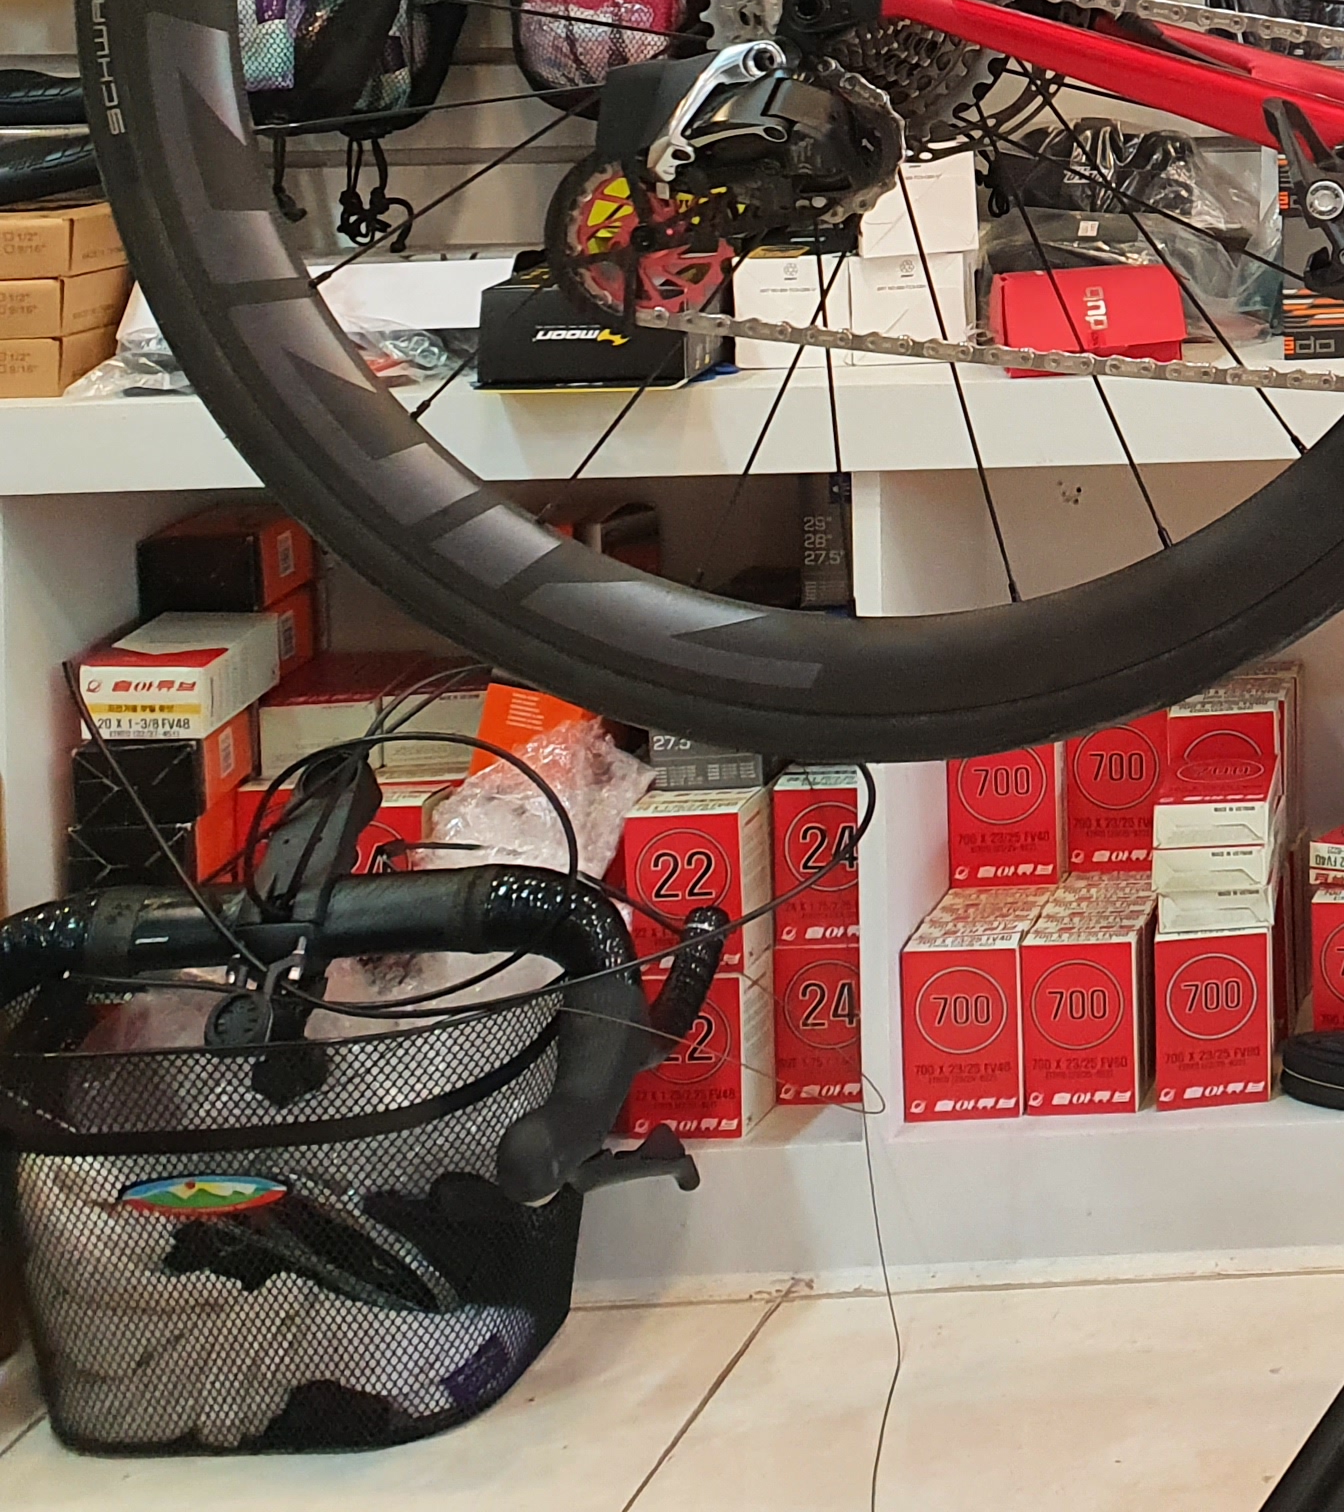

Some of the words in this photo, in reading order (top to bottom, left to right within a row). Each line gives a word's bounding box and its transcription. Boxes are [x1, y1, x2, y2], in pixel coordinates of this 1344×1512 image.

[1083, 285, 1105, 331] dub
[532, 329, 601, 343] moon
[116, 718, 124, 731] X
[128, 717, 160, 731] 1-3/8
[161, 717, 191, 731] FV48
[973, 767, 1031, 798] 700
[1089, 752, 1145, 783] 700
[799, 825, 859, 873] 24
[650, 849, 714, 901] 22
[799, 981, 860, 1030] 24
[930, 995, 992, 1027] 700
[1047, 989, 1108, 1022] 700
[1181, 980, 1242, 1013] 700
